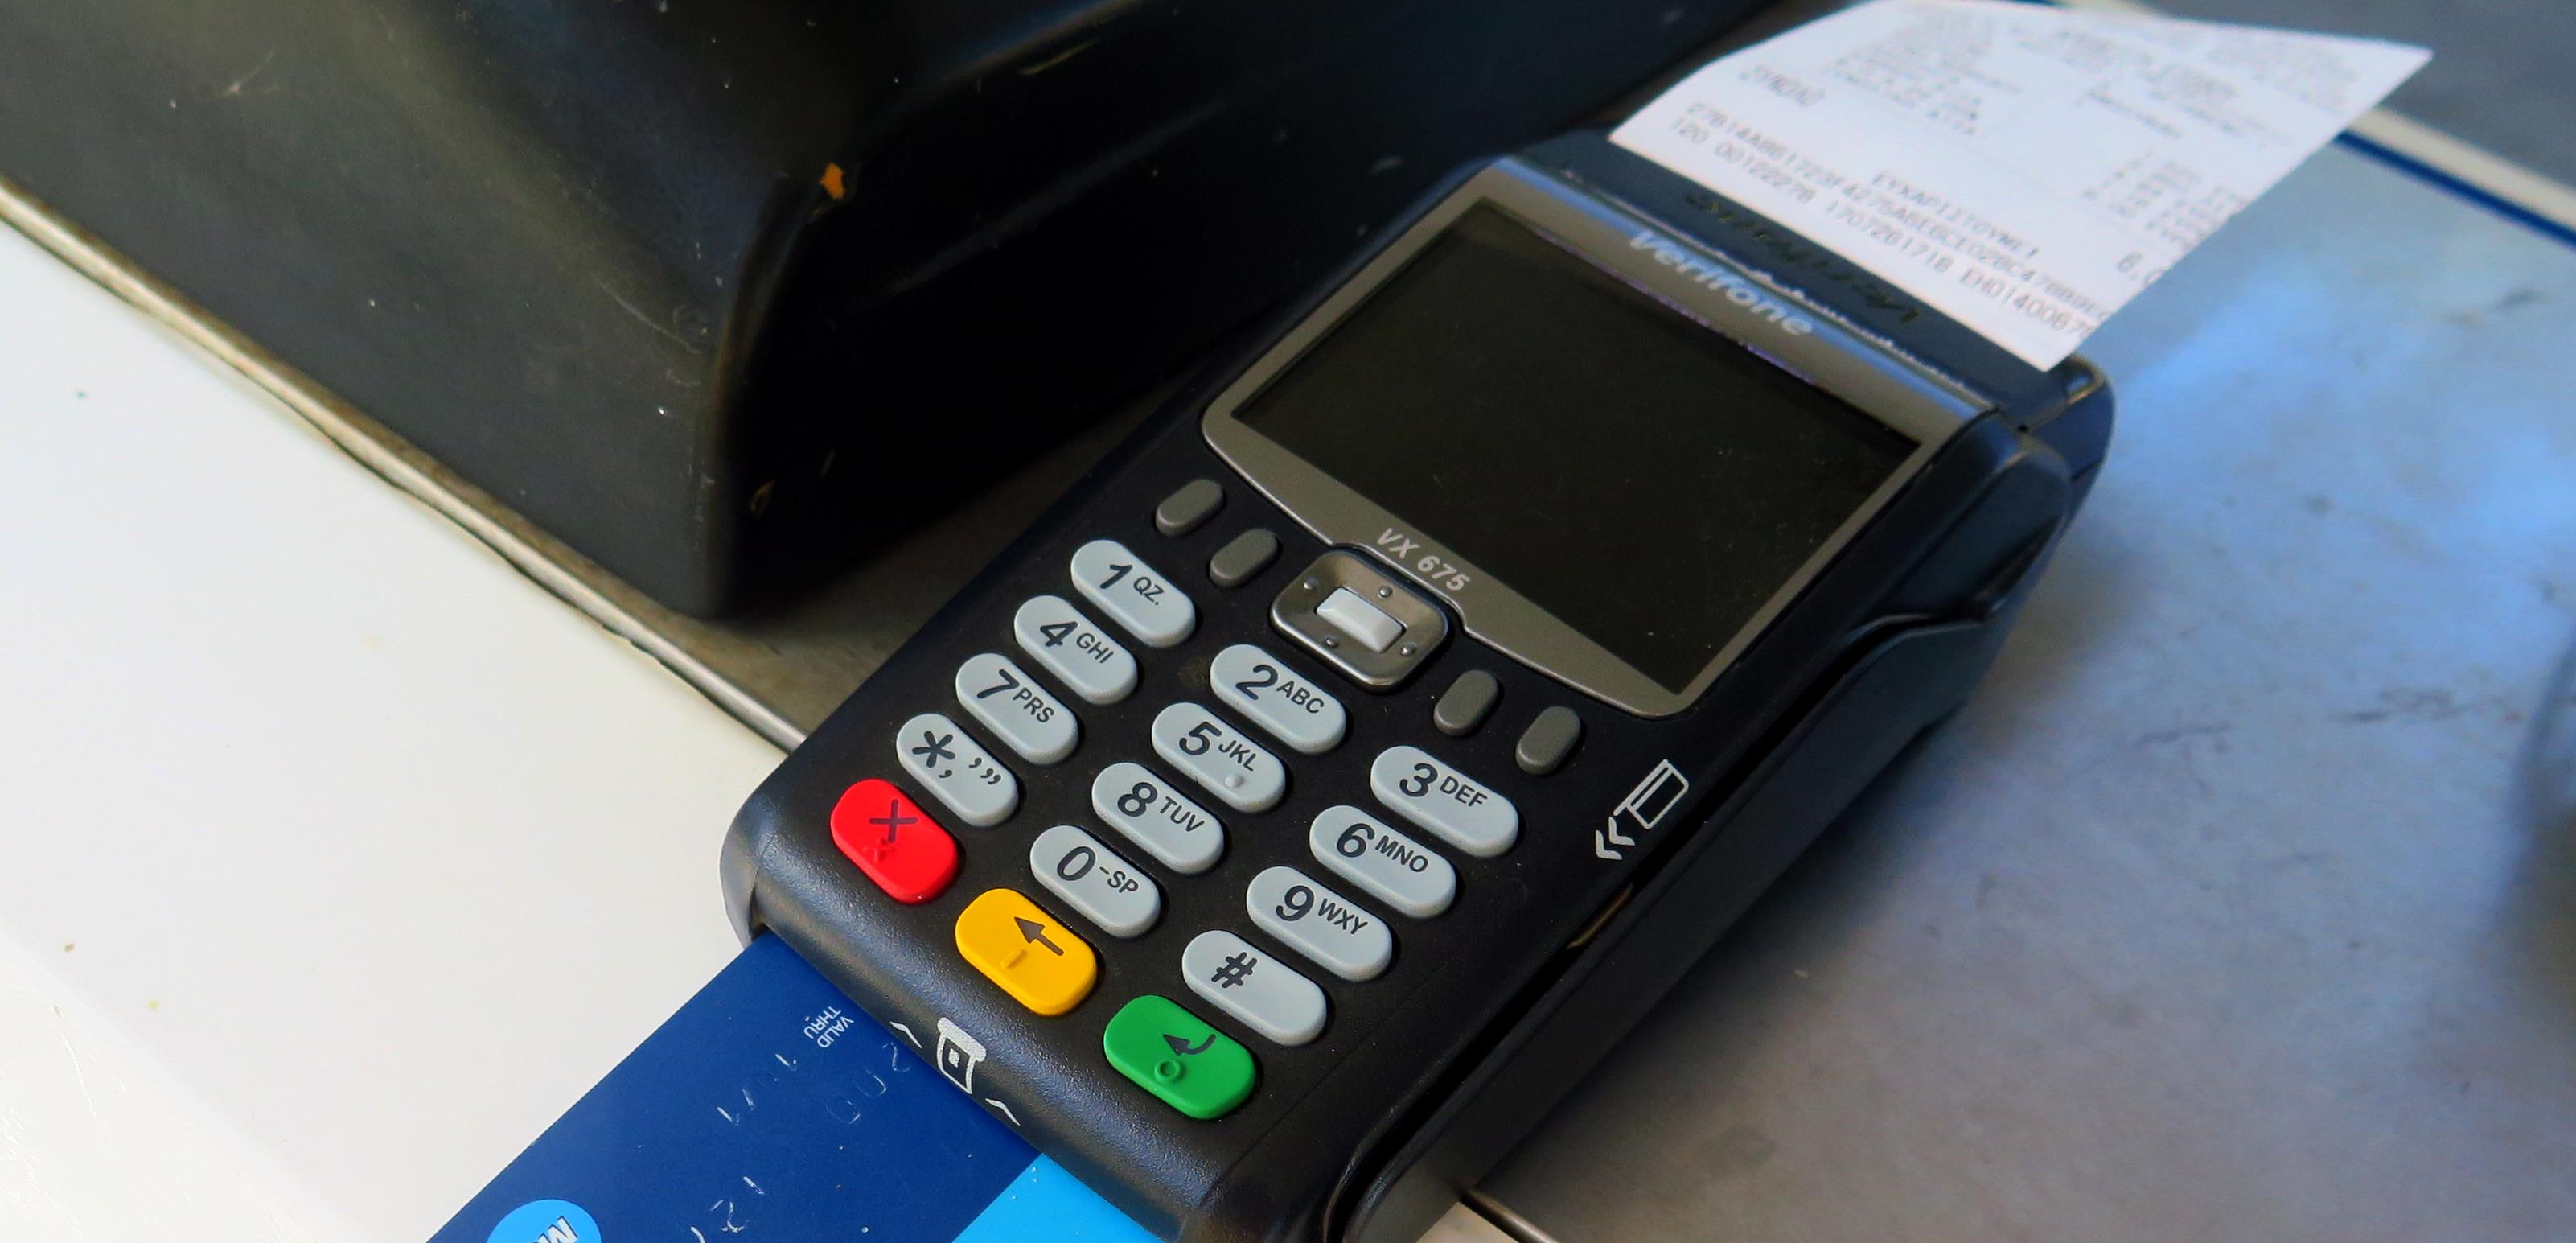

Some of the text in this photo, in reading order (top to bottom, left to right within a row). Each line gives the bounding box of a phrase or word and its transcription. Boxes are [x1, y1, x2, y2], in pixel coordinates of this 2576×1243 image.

[1099, 563, 1132, 589] 1
[1377, 527, 1471, 591] VX 675
[1039, 621, 1115, 664] 4 GHI
[976, 669, 1055, 724] 7 PRS
[1235, 664, 1325, 714] 2 ABC
[1178, 721, 1259, 772] 5 JKL
[1116, 781, 1205, 833] 8 TUV
[1399, 762, 1488, 809] 3 DEF
[1056, 846, 1096, 882] 0
[1337, 822, 1428, 874] 6 MNO
[1275, 884, 1368, 936] 9 WXY
[803, 1006, 841, 1039] THRU
[817, 1015, 854, 1048] VALID
